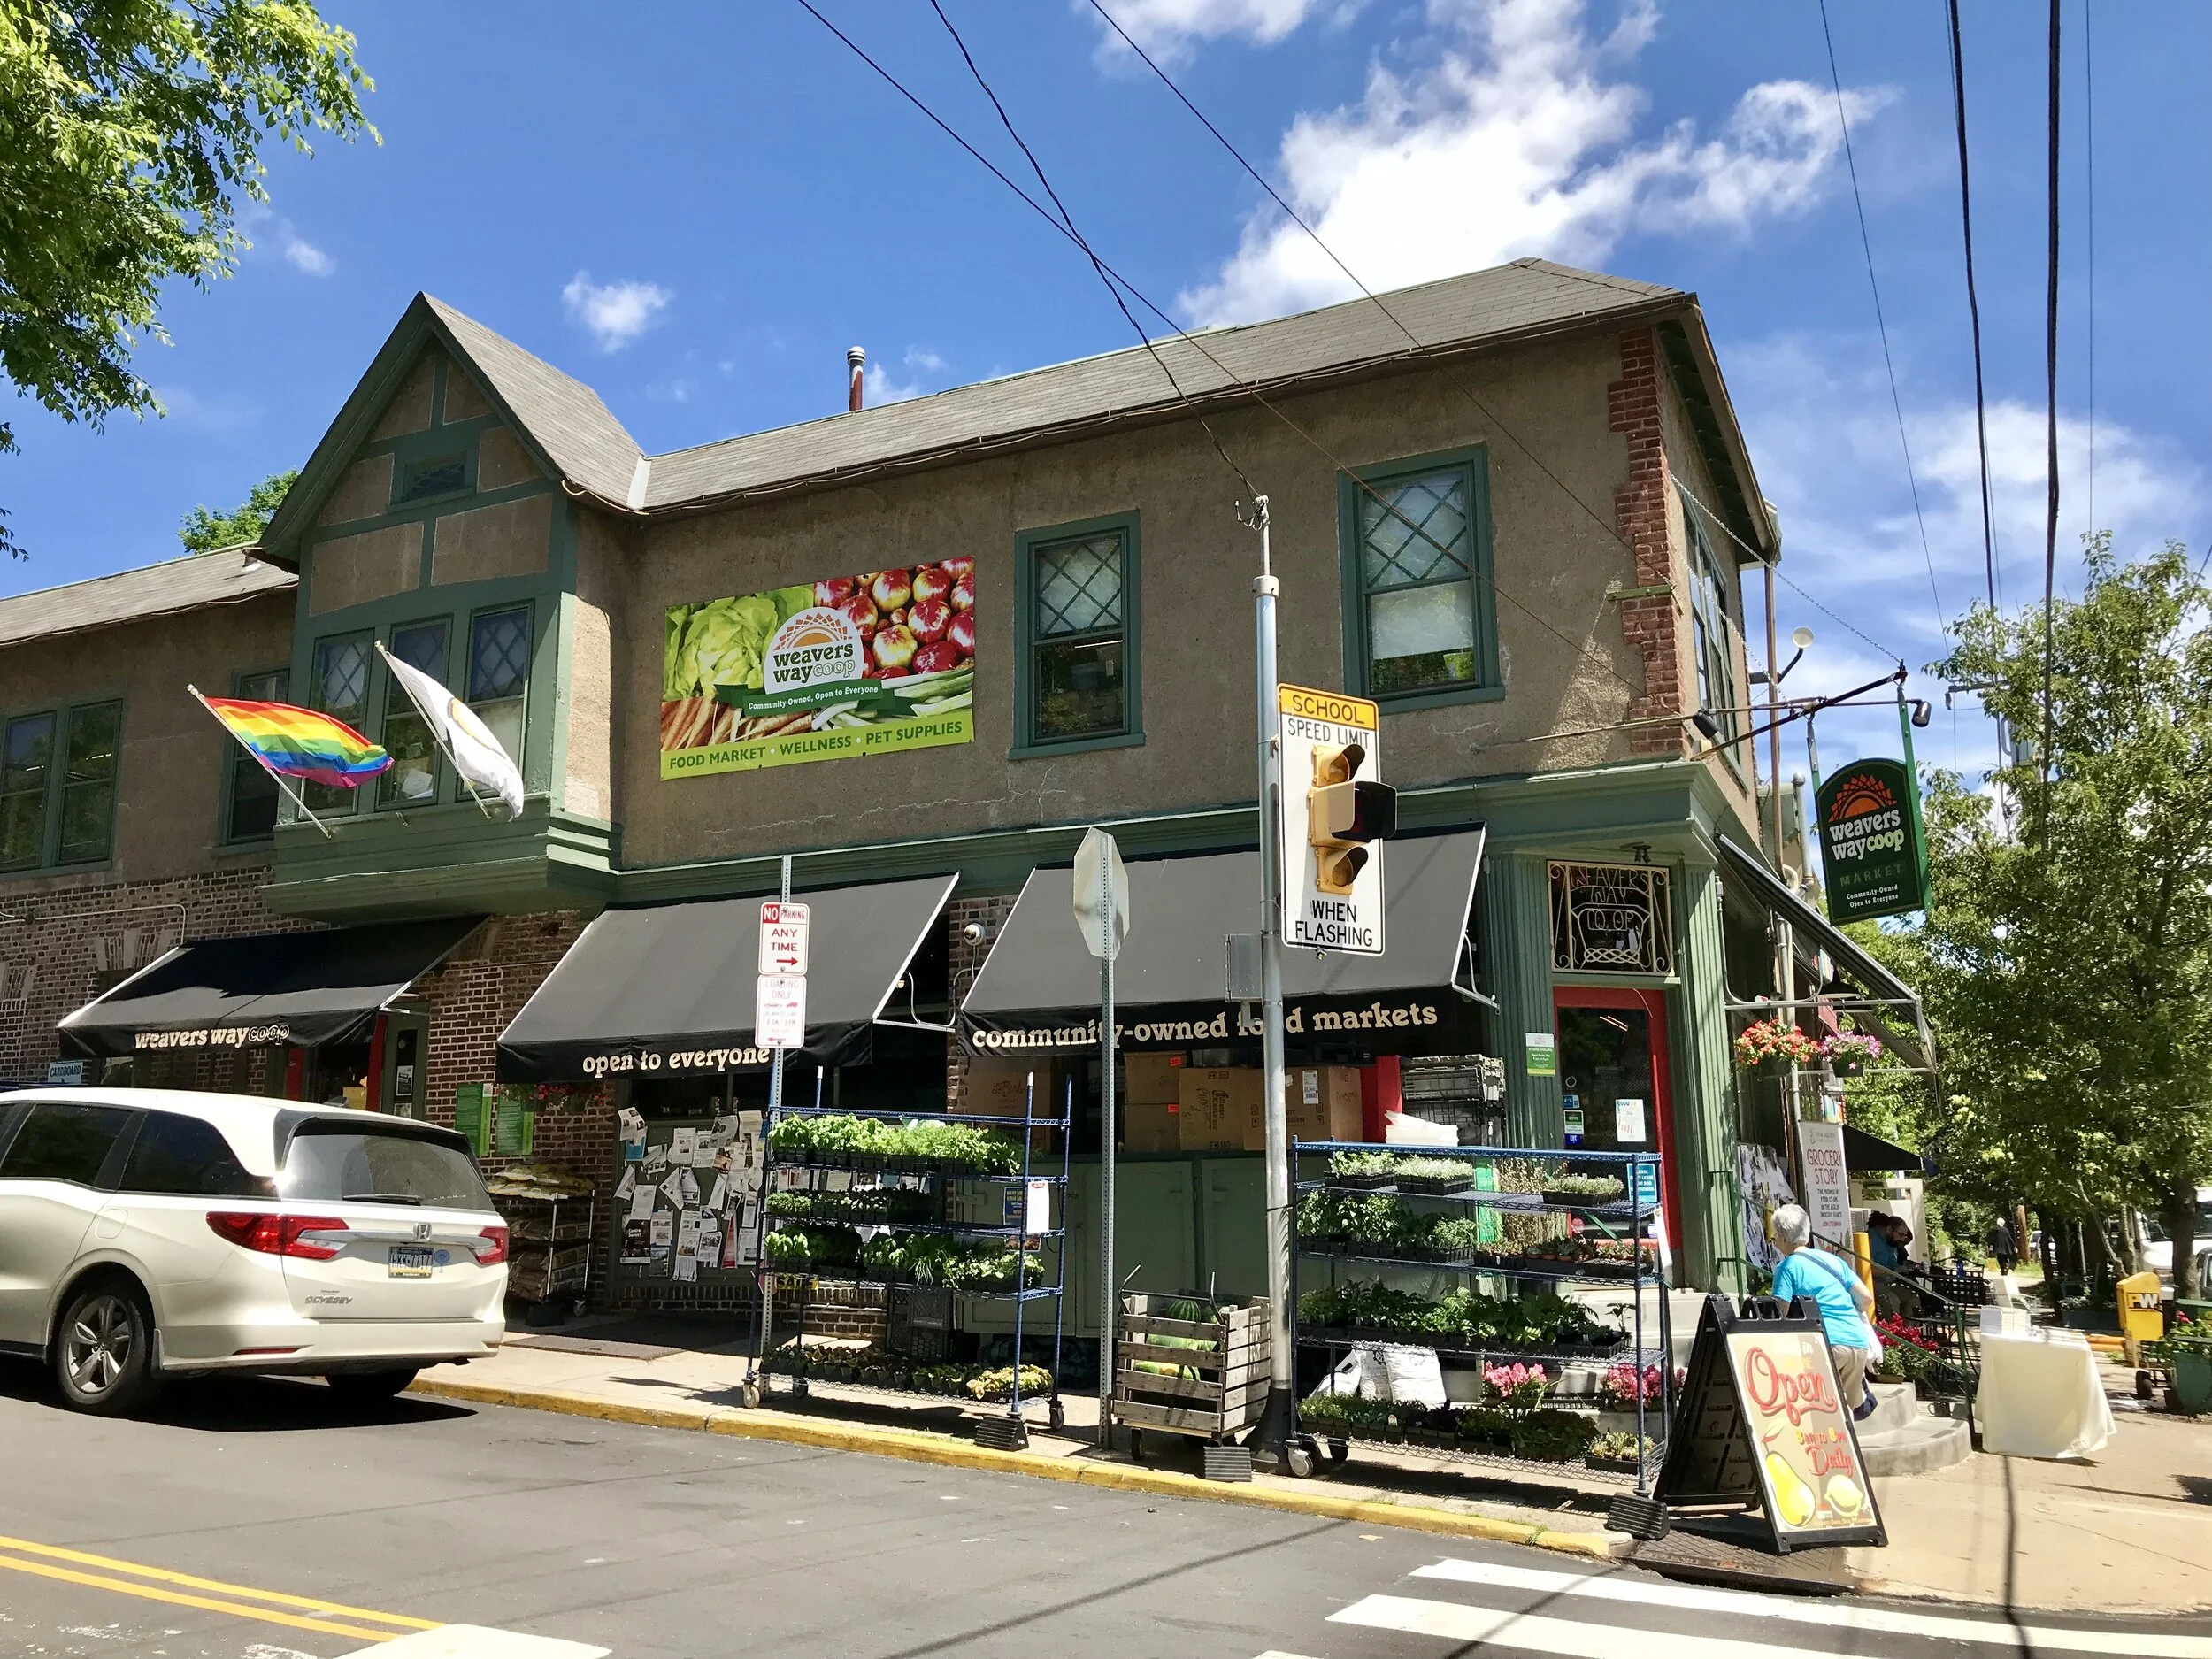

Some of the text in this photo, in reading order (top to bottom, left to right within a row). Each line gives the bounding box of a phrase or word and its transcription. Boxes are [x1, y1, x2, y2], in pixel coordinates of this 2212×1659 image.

[773, 643, 854, 667] weavers
[773, 665, 813, 683] way
[749, 695, 813, 710] Community-Owned,
[815, 691, 833, 701] Open
[844, 686, 879, 695] Everyone
[1293, 695, 1364, 724] SCHOOL
[1288, 718, 1370, 749] SPEED LIMIT
[670, 721, 963, 770] FOOD MARKET WELLNESS PET SUPPLIES
[1829, 809, 1901, 841] weavers
[1832, 837, 1867, 860] way
[1839, 864, 1902, 887] MARKET
[1847, 884, 1898, 900] Community-Owned
[1872, 894, 1899, 904] Everyone
[764, 907, 805, 920] NO PARKING
[1312, 900, 1356, 923] WHEN
[772, 928, 798, 937] ANY
[1295, 920, 1373, 947] FLASHING
[771, 942, 798, 951] TIME
[764, 979, 798, 989] LOADING
[772, 990, 792, 999] ONLY
[1313, 1002, 1438, 1030] markets
[134, 1029, 208, 1048] weavers
[210, 1026, 250, 1048] way
[583, 1047, 770, 1078] open to everyone
[1807, 1149, 1842, 1166] GROCERY
[1815, 1168, 1838, 1185] STORY
[1744, 1347, 1838, 1426] Open
[1805, 1445, 1854, 1477] Daily
